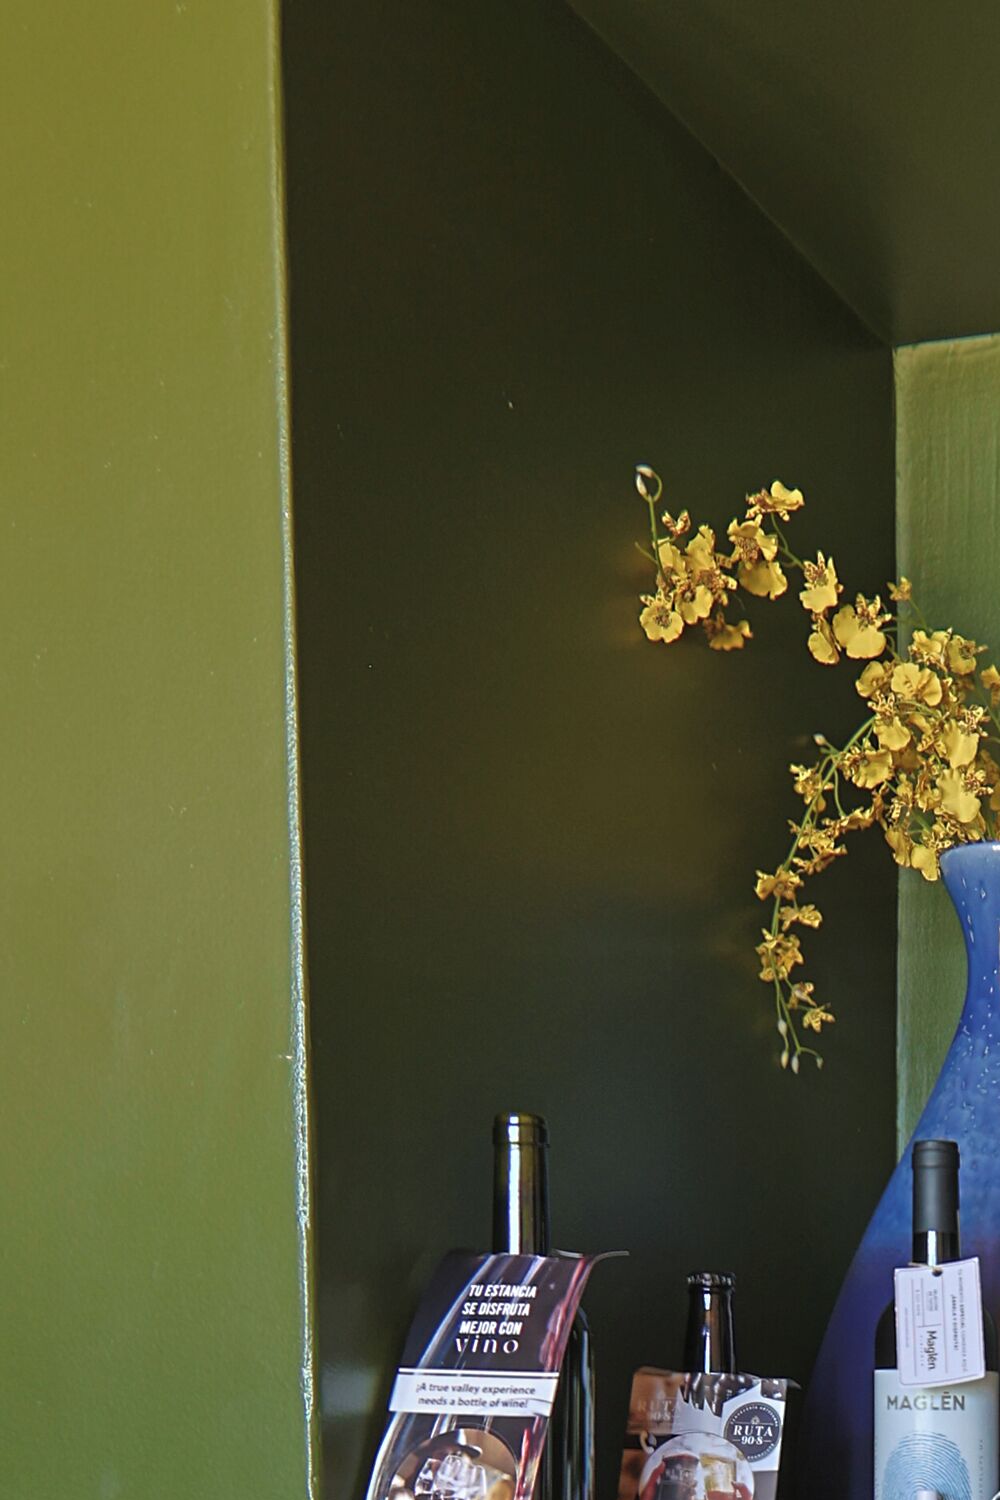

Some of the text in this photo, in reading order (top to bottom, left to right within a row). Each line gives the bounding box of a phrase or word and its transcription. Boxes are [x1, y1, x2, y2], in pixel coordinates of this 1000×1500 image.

[469, 1284, 537, 1299] TU ESTANCIA
[462, 1302, 531, 1316] SE DISFRUTA
[459, 1321, 522, 1335] MEJOR CON
[456, 1335, 519, 1354] vino
[925, 1330, 938, 1370] Maglén
[429, 1384, 449, 1392] true
[451, 1384, 480, 1395] valley
[482, 1385, 536, 1395] experience
[418, 1397, 447, 1406] needs
[458, 1397, 487, 1407] bottle
[489, 1398, 501, 1408] of
[501, 1399, 529, 1408] wine!
[733, 1425, 773, 1437] RUTA
